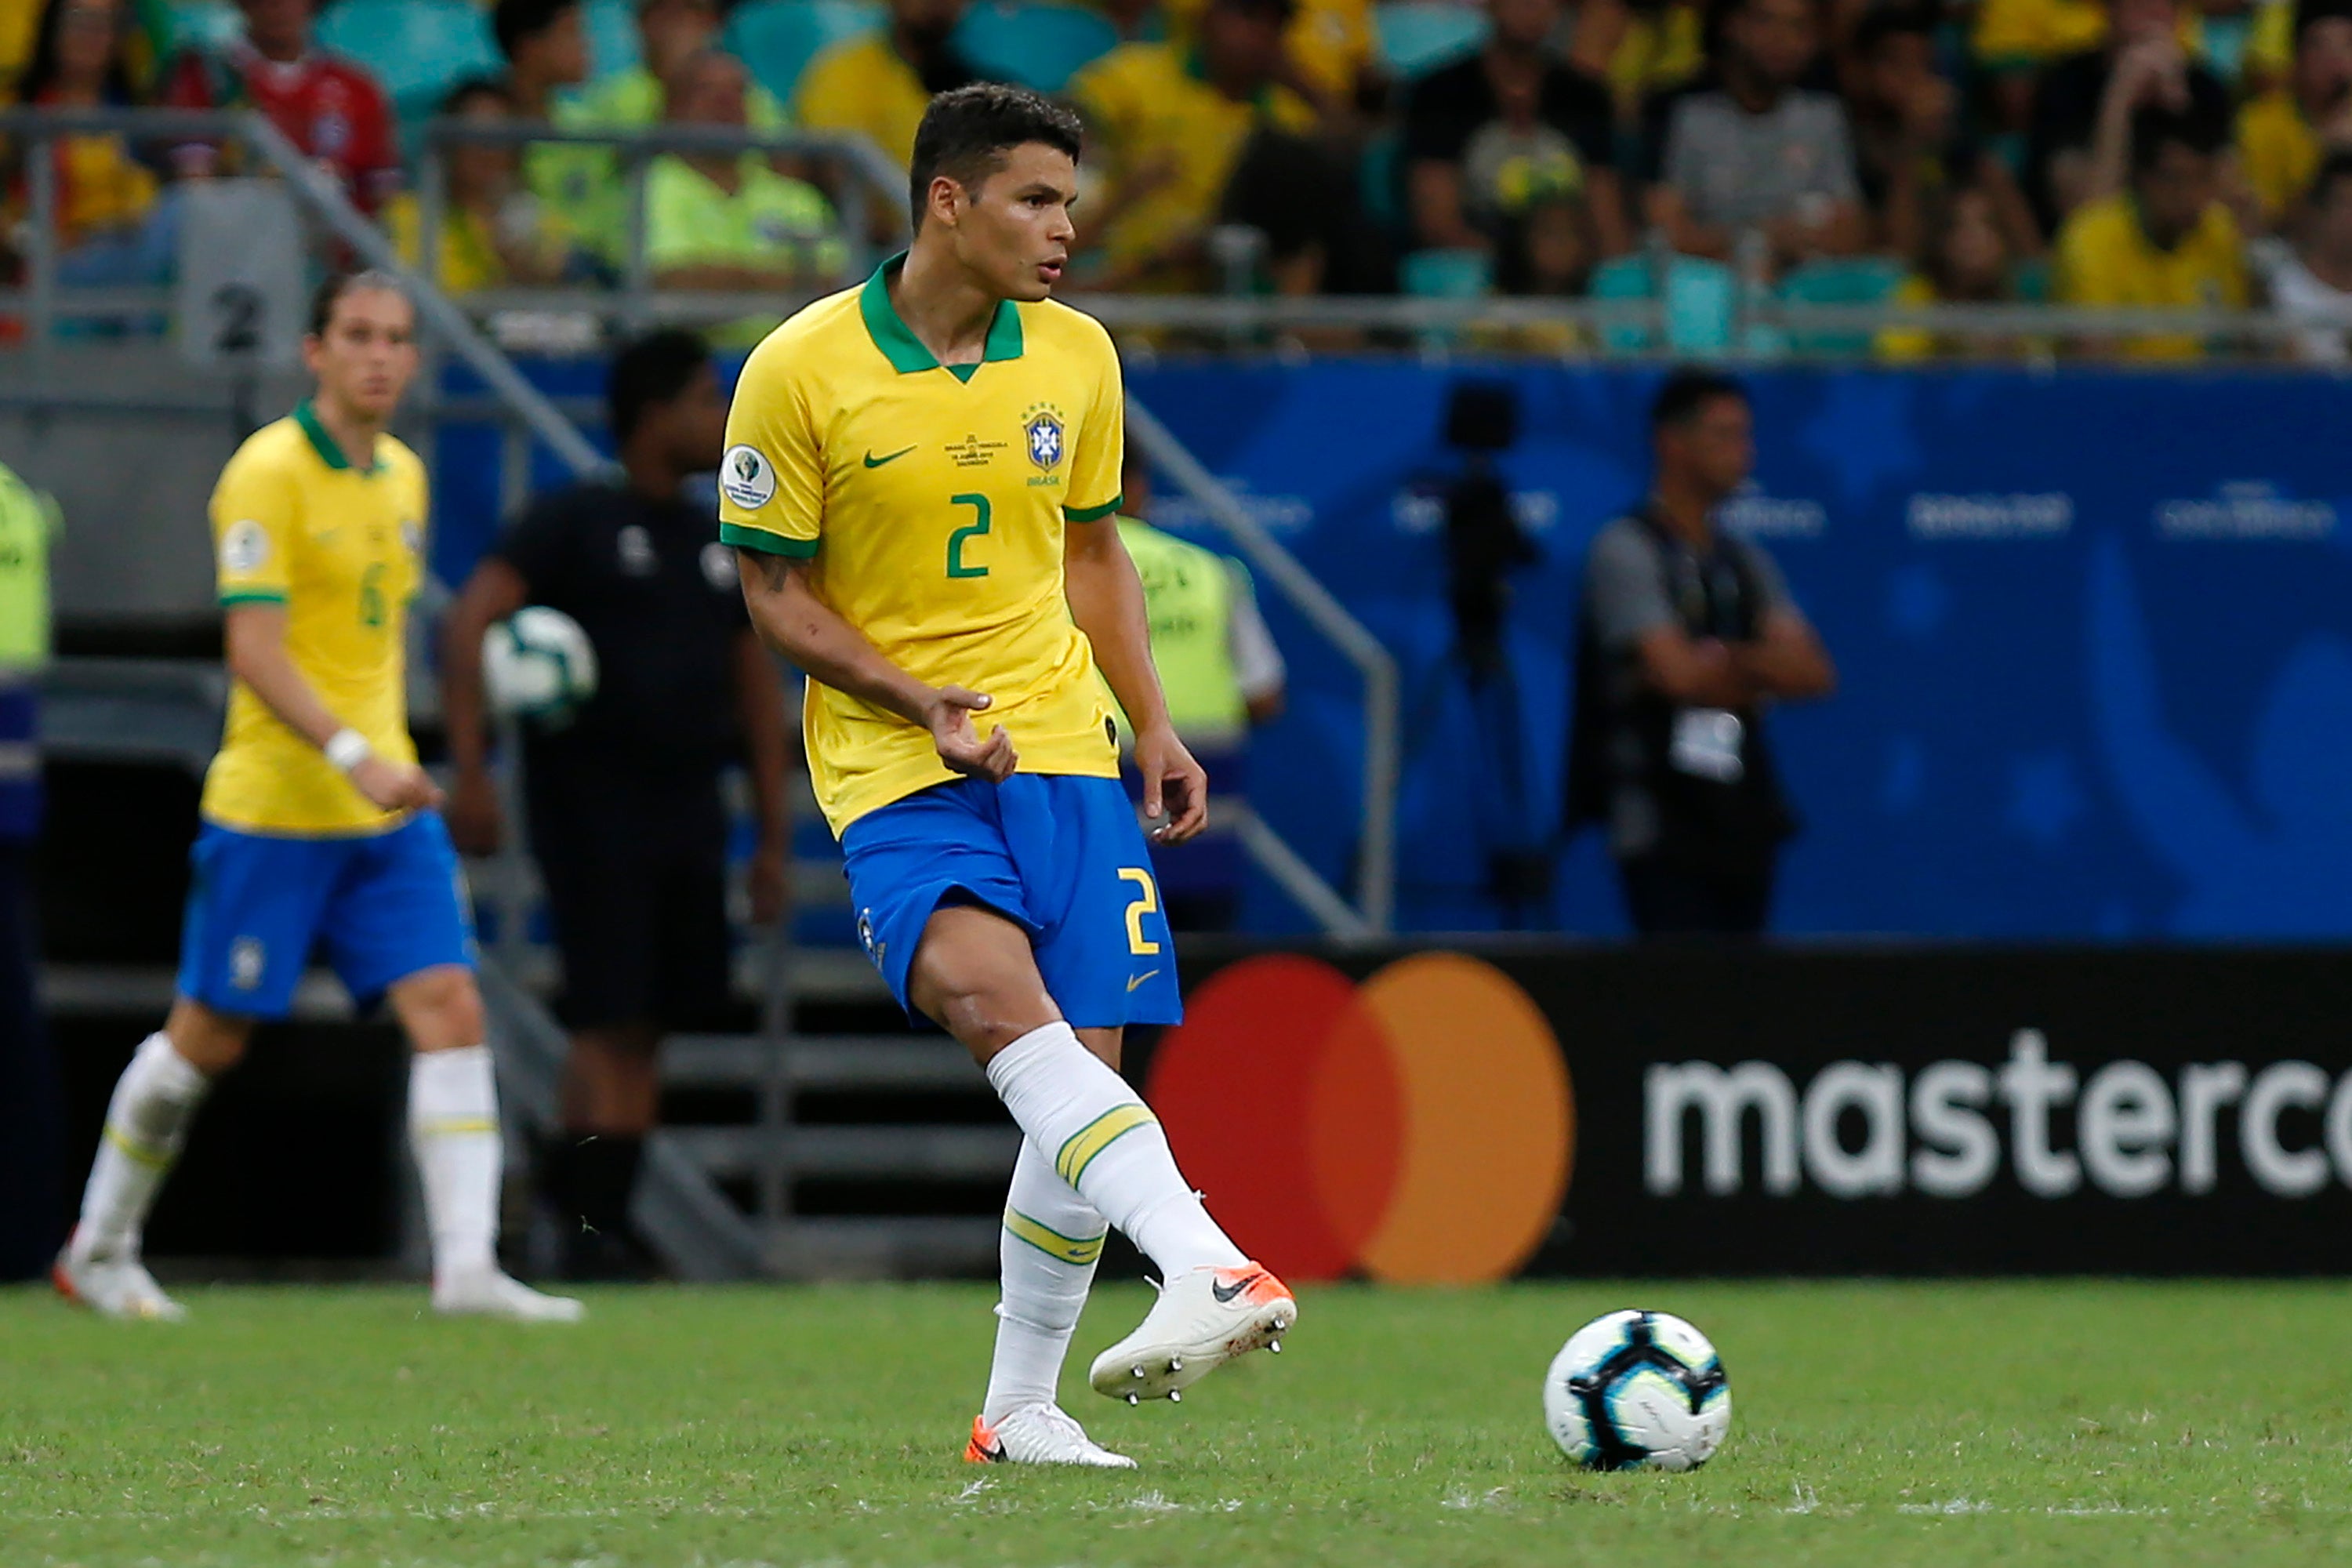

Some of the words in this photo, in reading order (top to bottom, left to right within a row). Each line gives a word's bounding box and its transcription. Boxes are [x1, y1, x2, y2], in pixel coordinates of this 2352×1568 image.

[213, 284, 265, 351] 2
[946, 493, 992, 579] 2
[1117, 867, 1160, 956] 2
